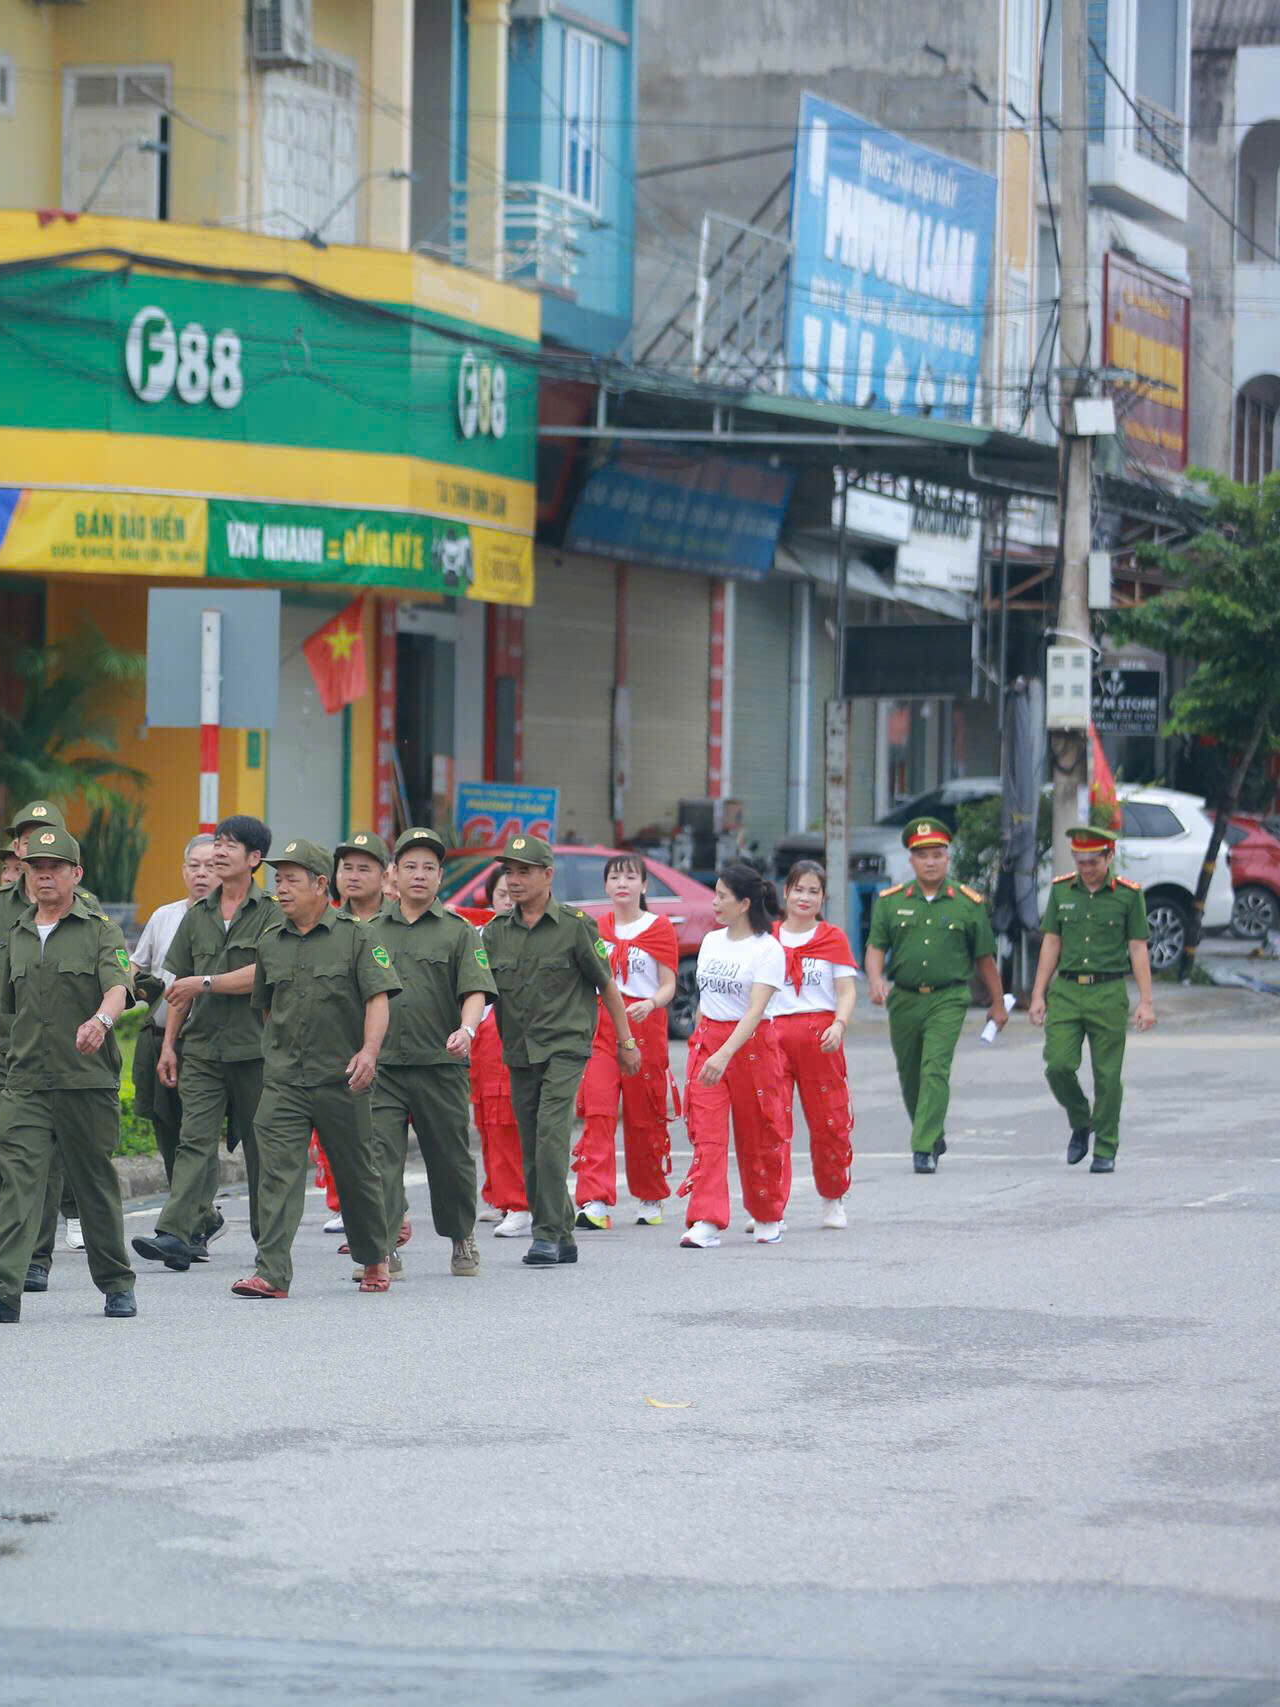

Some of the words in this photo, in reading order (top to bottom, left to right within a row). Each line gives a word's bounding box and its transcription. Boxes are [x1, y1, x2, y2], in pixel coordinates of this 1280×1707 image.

[919, 212, 977, 307] LOAN
[125, 305, 244, 409] F88
[457, 347, 507, 439] F88
[75, 508, 113, 539] BÁN
[227, 520, 259, 560] VAY
[262, 523, 324, 564] NHANH
[1117, 698, 1158, 712] STORE
[463, 815, 552, 849] GAS
